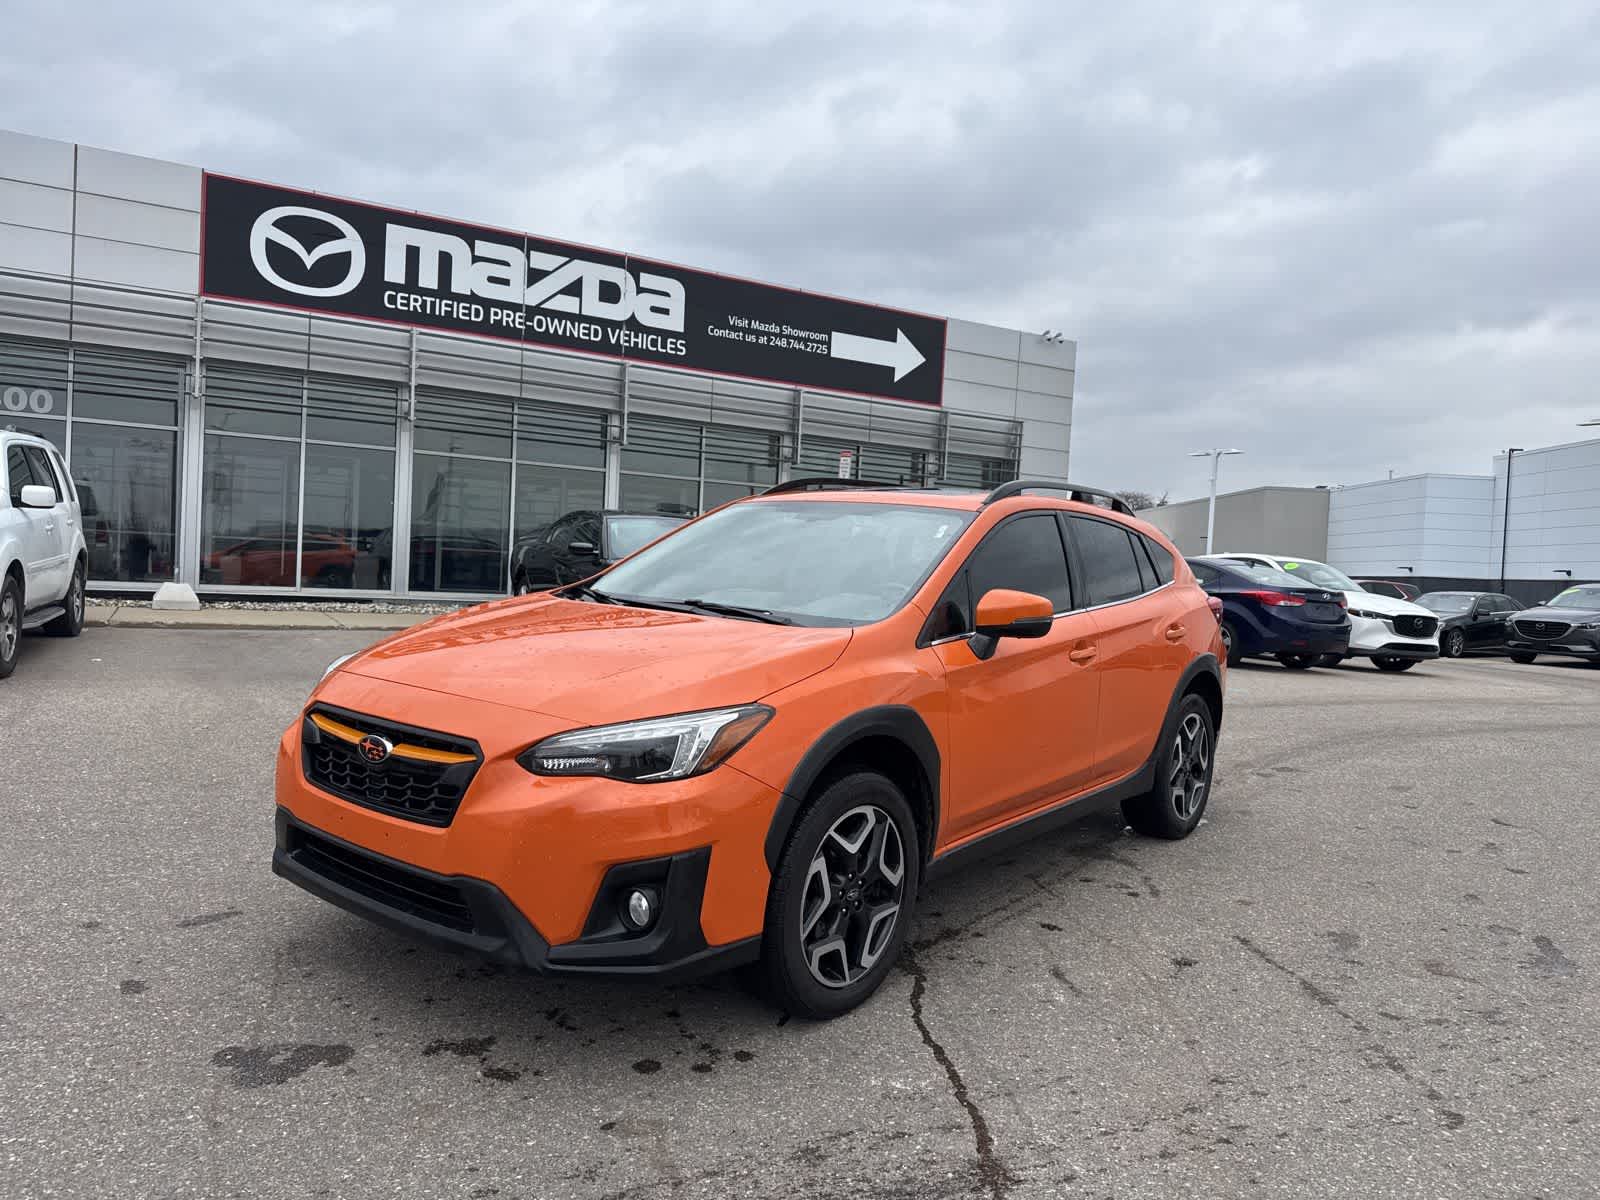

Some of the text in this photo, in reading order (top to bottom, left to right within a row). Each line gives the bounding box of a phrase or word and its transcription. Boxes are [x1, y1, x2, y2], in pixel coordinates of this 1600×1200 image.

[383, 290, 687, 356] CERTIFIED PRE-OWNED VEHICLES
[728, 315, 829, 342] Visit Mazda Showroom
[707, 325, 828, 354] Contact us at 248.744.2725
[0, 386, 53, 413] 00
